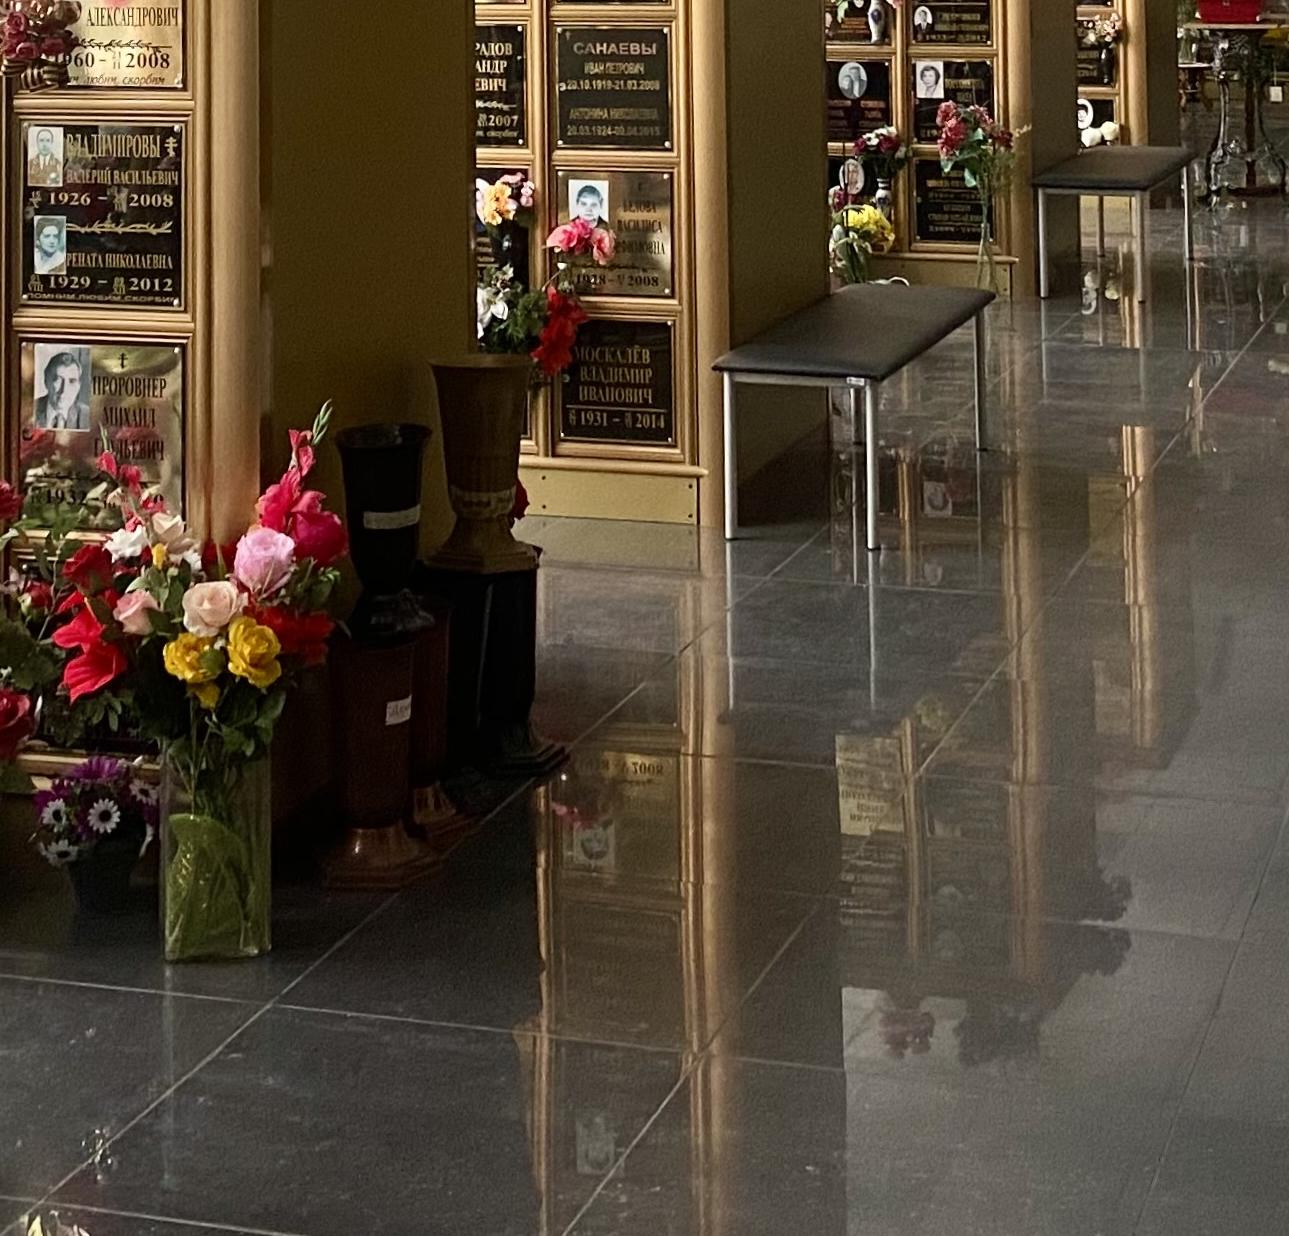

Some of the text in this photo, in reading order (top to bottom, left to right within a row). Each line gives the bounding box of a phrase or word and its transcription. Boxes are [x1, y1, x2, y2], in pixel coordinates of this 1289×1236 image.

[86, 7, 179, 27] АЛЕКСАНДРОВИЧ
[573, 42, 657, 55] САНАЕВЫ
[125, 51, 170, 70] 2008
[488, 114, 518, 127] 2007
[65, 133, 160, 159] ВЛАДИМИРОВЫ
[66, 169, 178, 185] ВАЛЕРИЙ ВАСИЛЬЕВИЧ
[48, 191, 174, 208] 1926 2008
[66, 254, 173, 270] РЕНАТА НИКОЛАЕВНА
[48, 275, 173, 291] 1929 2012
[628, 275, 659, 286] 2008
[580, 367, 653, 384] ВЛАДИМИР
[580, 386, 653, 404] ИВАНОВИЧ
[580, 411, 665, 428] 1931 2014
